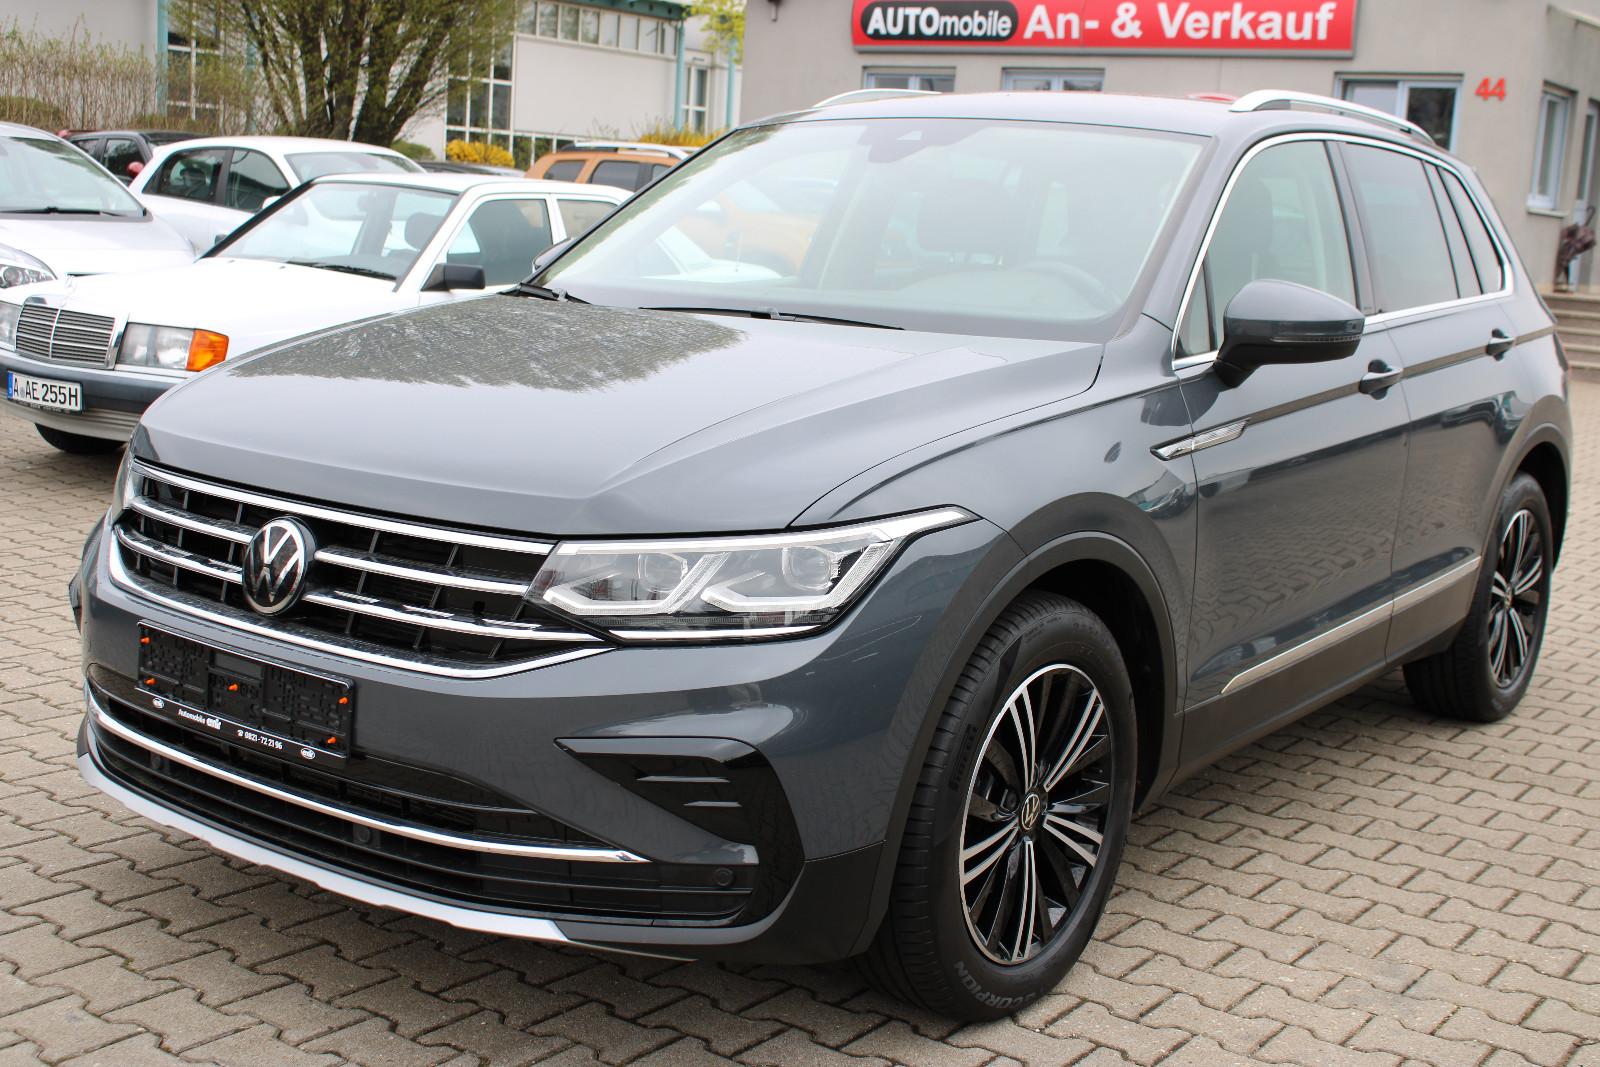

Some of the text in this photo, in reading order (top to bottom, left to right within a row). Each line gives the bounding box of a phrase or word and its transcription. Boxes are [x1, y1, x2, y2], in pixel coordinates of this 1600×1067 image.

[866, 6, 1012, 38] AUTOmobile
[1023, 1, 1337, 40] An- & Verkauf
[1474, 77, 1506, 102] 44
